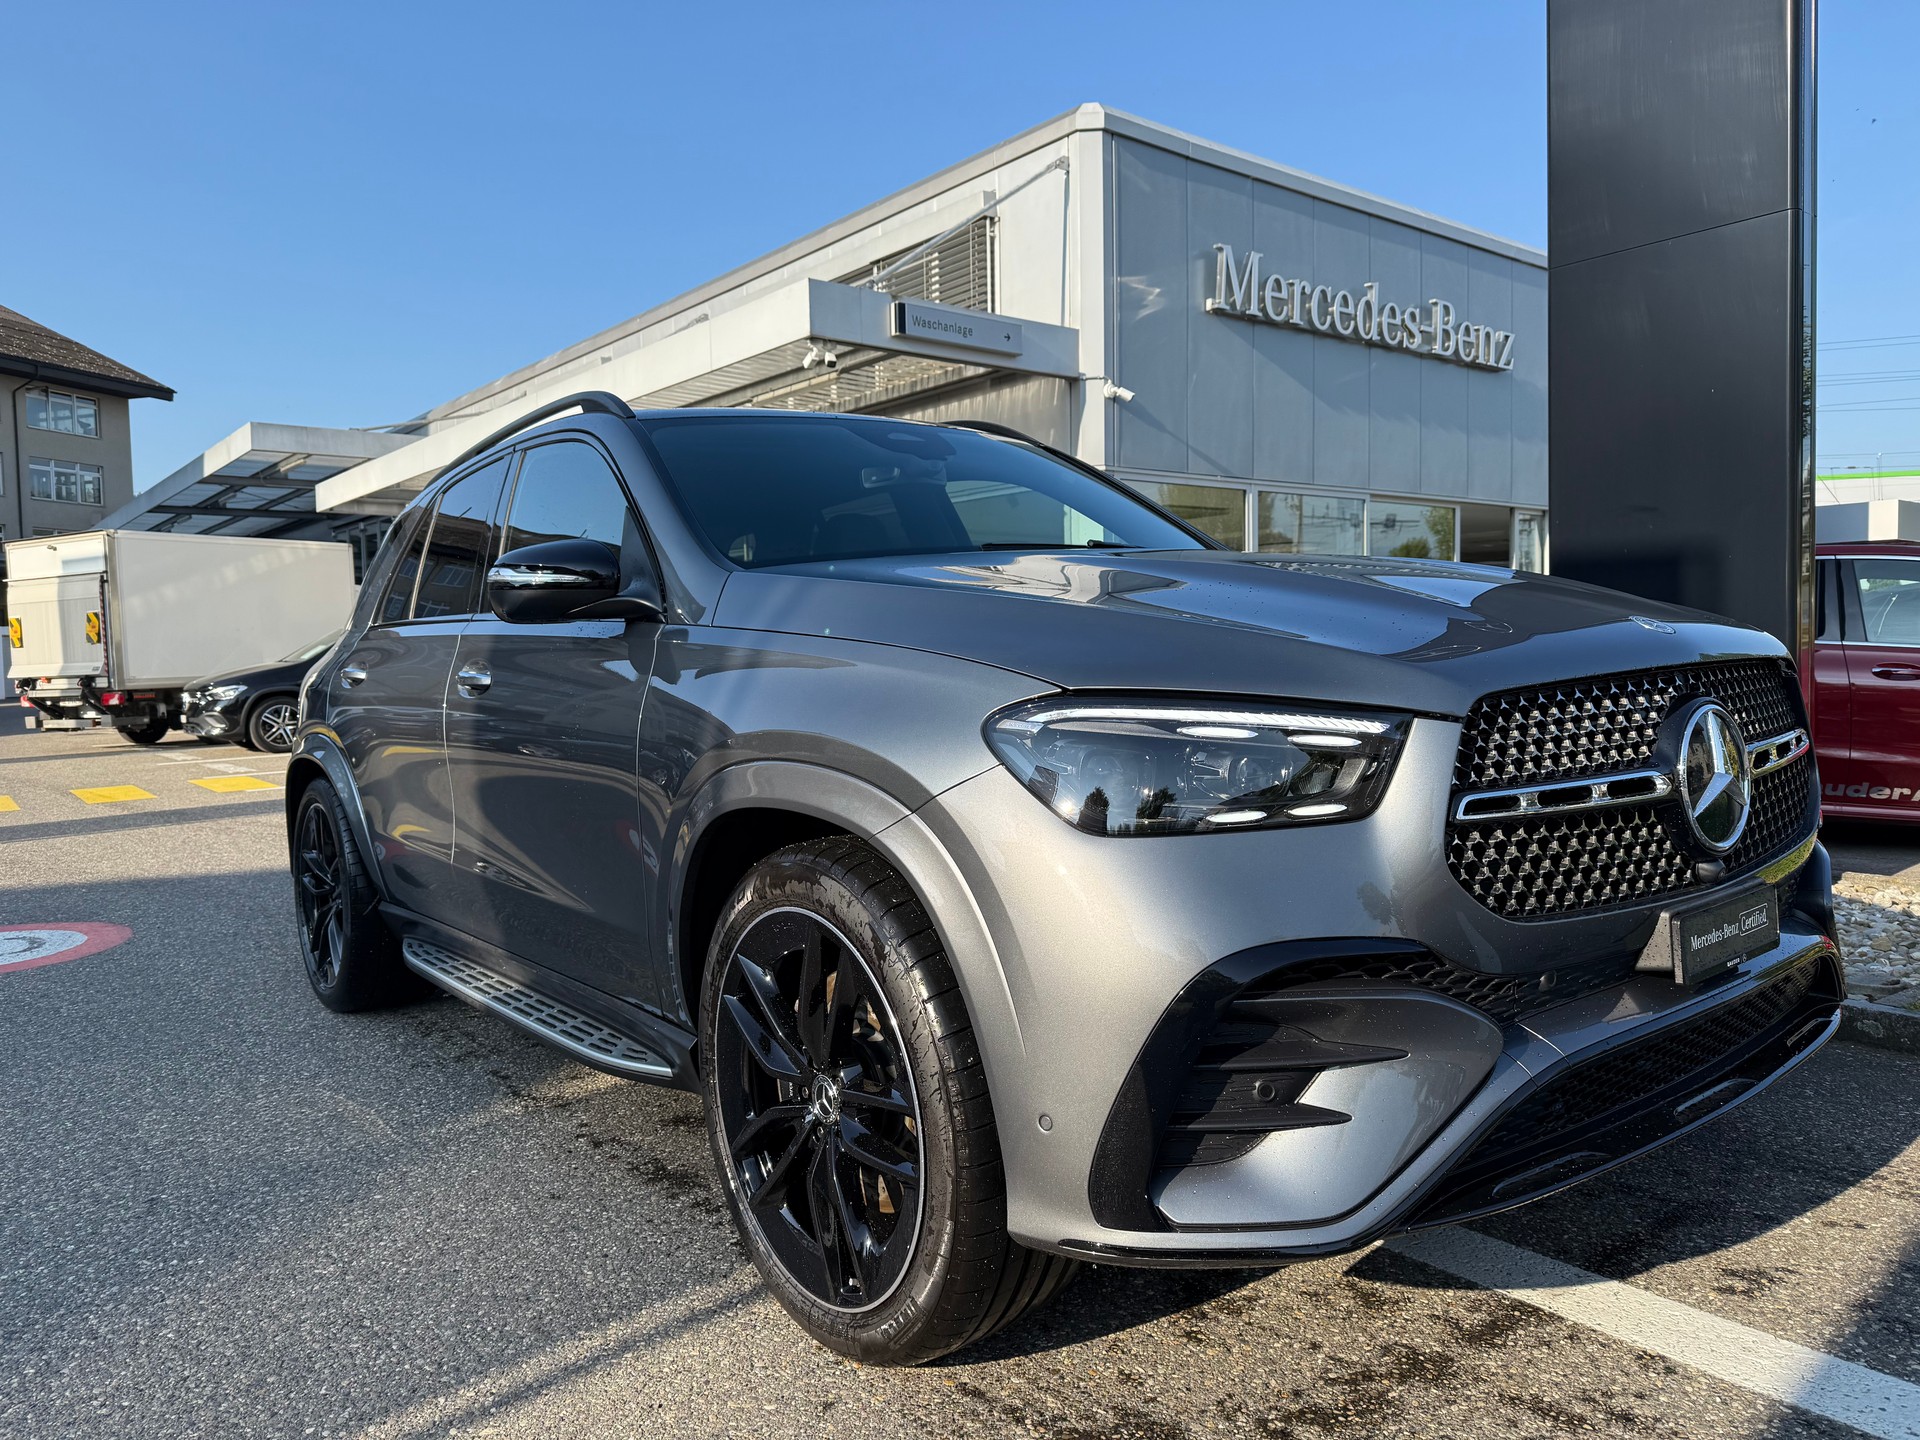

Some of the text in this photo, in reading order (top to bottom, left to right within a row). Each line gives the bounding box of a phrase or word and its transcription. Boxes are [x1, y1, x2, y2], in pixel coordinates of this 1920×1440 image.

[1206, 243, 1516, 370] Mercedes-Benz
[911, 314, 973, 338] Waschanlage
[1820, 782, 1912, 800] uder
[1690, 908, 1767, 951] Mercedes-Benz Certified
